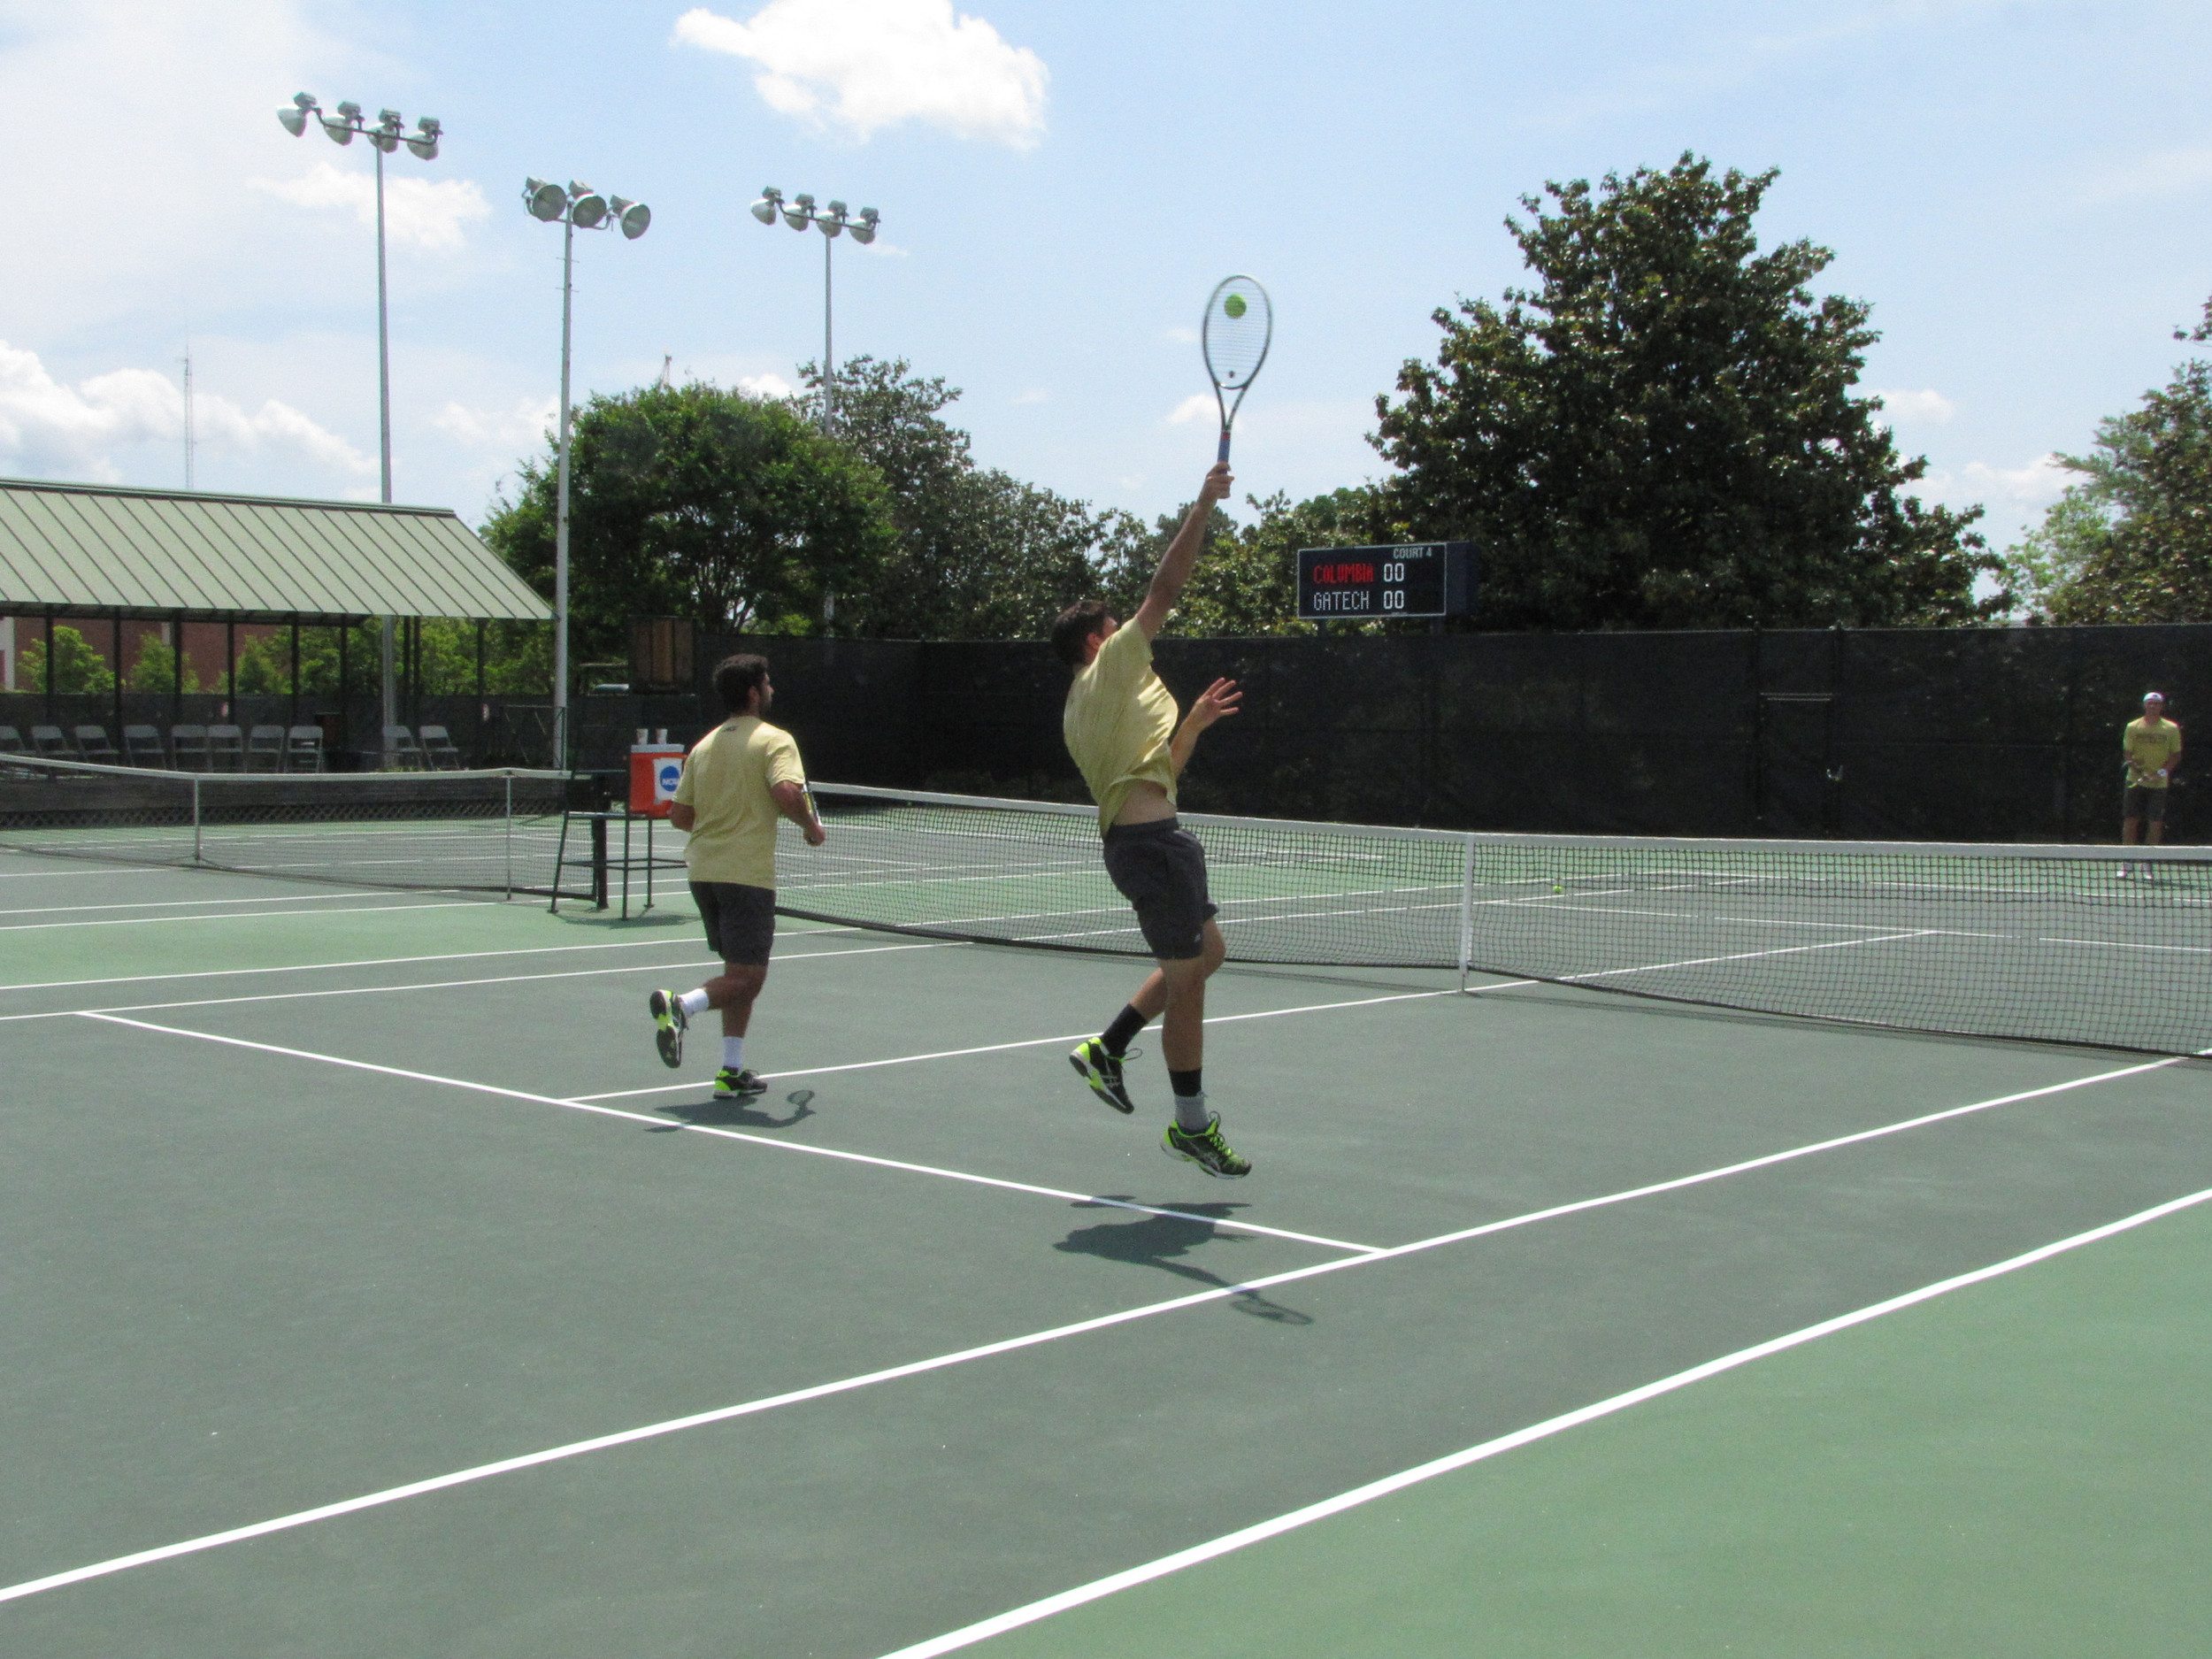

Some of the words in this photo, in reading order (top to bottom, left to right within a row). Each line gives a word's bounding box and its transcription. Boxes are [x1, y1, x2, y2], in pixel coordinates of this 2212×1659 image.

[1394, 547, 1423, 559] COURT
[1425, 546, 1432, 557] 4
[1314, 564, 1374, 583] COLUMBIA
[1384, 563, 1405, 582] 00
[1313, 590, 1370, 611] GATECH
[1383, 590, 1405, 610] 00
